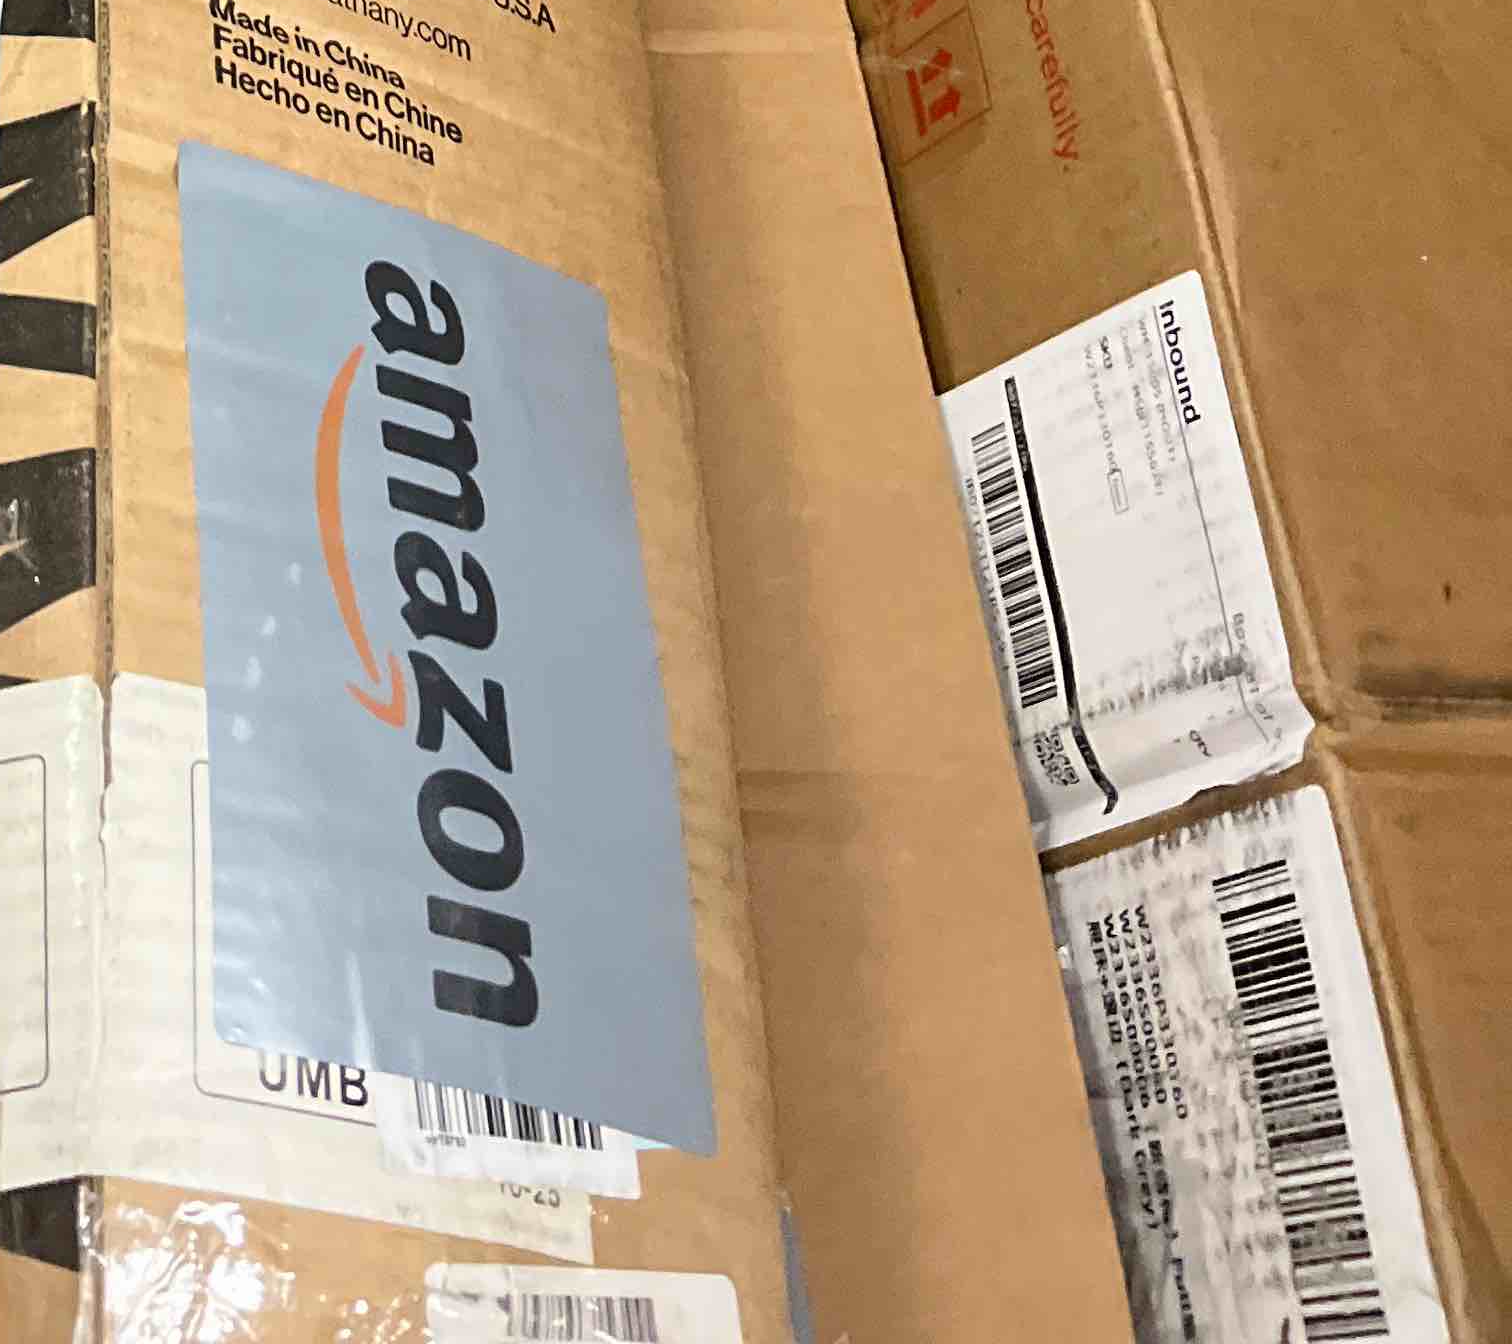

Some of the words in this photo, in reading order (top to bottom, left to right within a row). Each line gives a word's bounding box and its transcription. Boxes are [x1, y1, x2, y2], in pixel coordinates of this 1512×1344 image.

[214, 22, 340, 97] Fabriqué
[346, 81, 380, 111] en
[385, 91, 463, 144] Chine
[214, 56, 310, 114] Hecho
[316, 101, 352, 132] en
[355, 114, 436, 165] China
[295, 26, 320, 57] in
[325, 39, 405, 90] China
[1158, 300, 1202, 425] Inbound
[365, 259, 541, 1028] amazon
